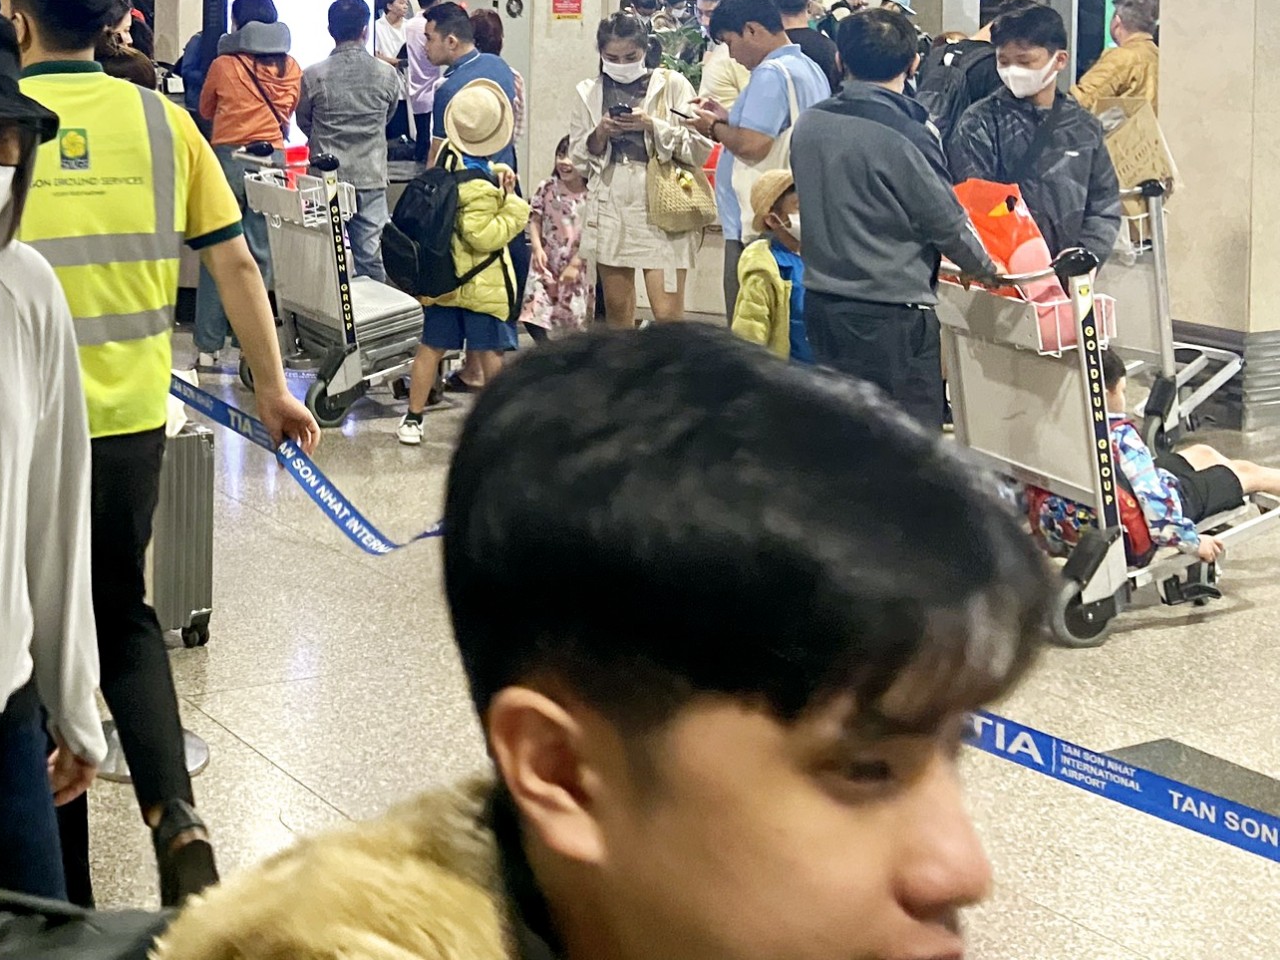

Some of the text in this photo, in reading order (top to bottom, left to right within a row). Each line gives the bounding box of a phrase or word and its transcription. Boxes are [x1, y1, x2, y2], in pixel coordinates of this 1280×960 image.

[330, 205, 353, 331] GOLDSUN GROUP
[227, 407, 253, 437] TIA
[1084, 325, 1114, 506] GOLDSUN GROUP
[277, 441, 297, 460] AN
[292, 457, 320, 488] SON
[315, 484, 351, 519] NHAT
[972, 715, 1046, 766] TIA
[1060, 743, 1137, 778] TAN SON NHAT
[1060, 754, 1144, 793] INTERNATIONAL
[1060, 766, 1107, 790] AIRPORT
[1168, 789, 1280, 848] TAN SON
